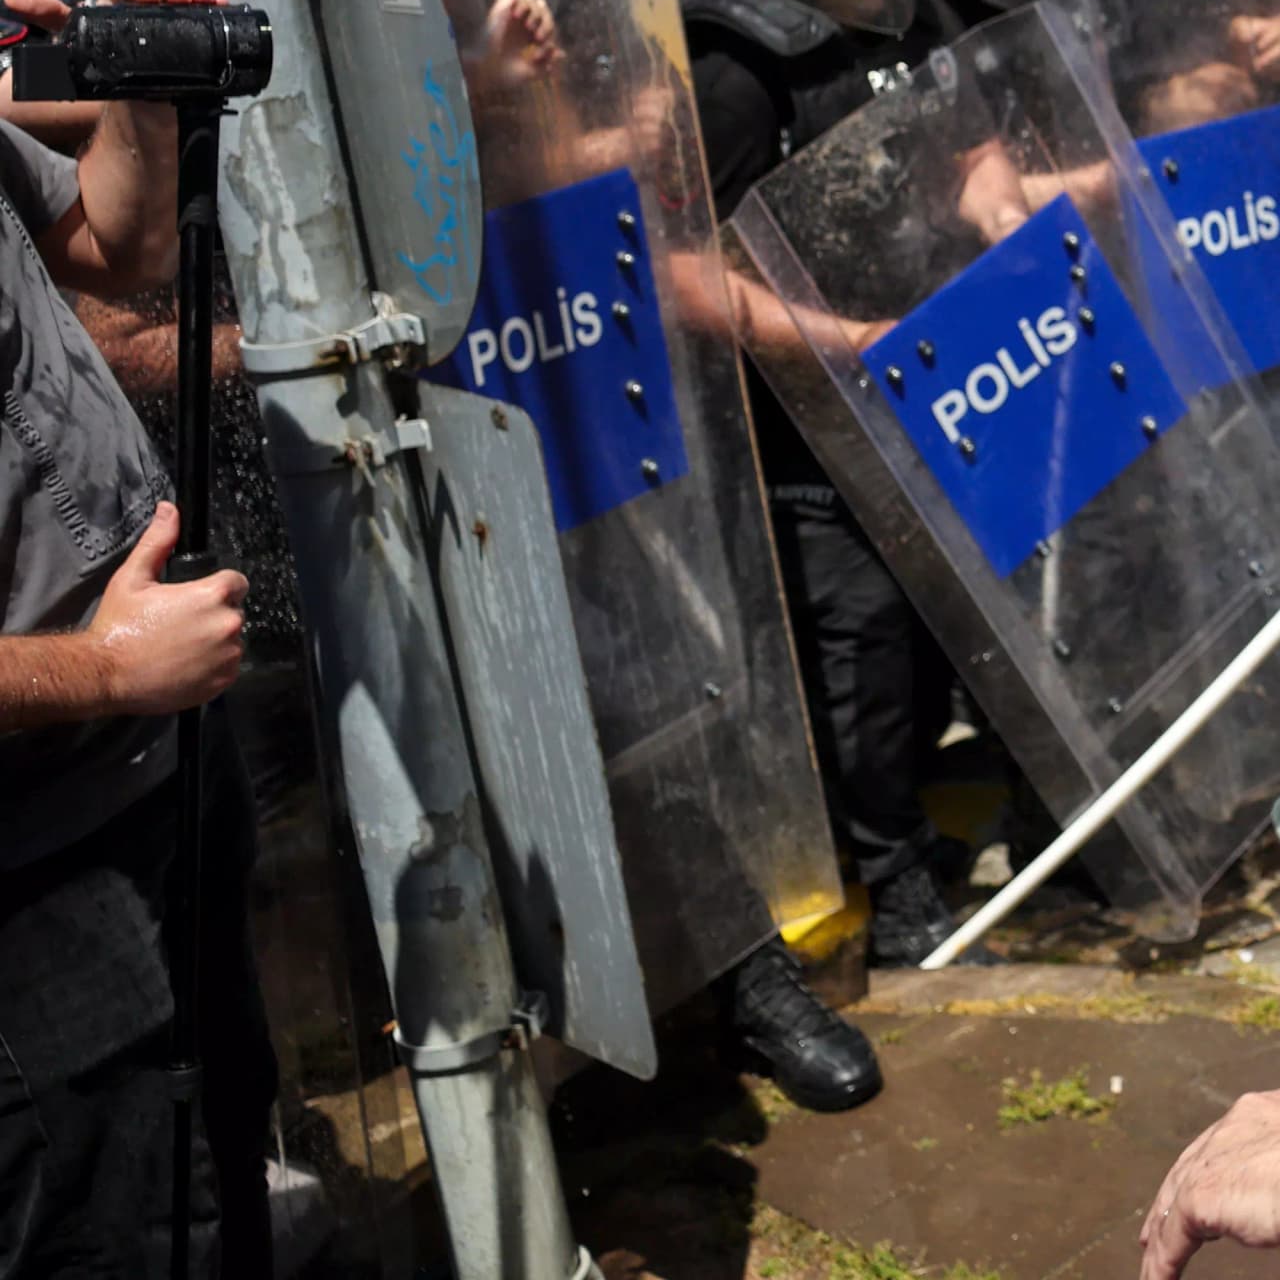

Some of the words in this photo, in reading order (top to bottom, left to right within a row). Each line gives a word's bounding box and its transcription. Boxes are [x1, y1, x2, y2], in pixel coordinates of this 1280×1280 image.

[1176, 190, 1280, 261] POLİS
[467, 286, 603, 388] POLİS
[931, 306, 1077, 445] POLİS
